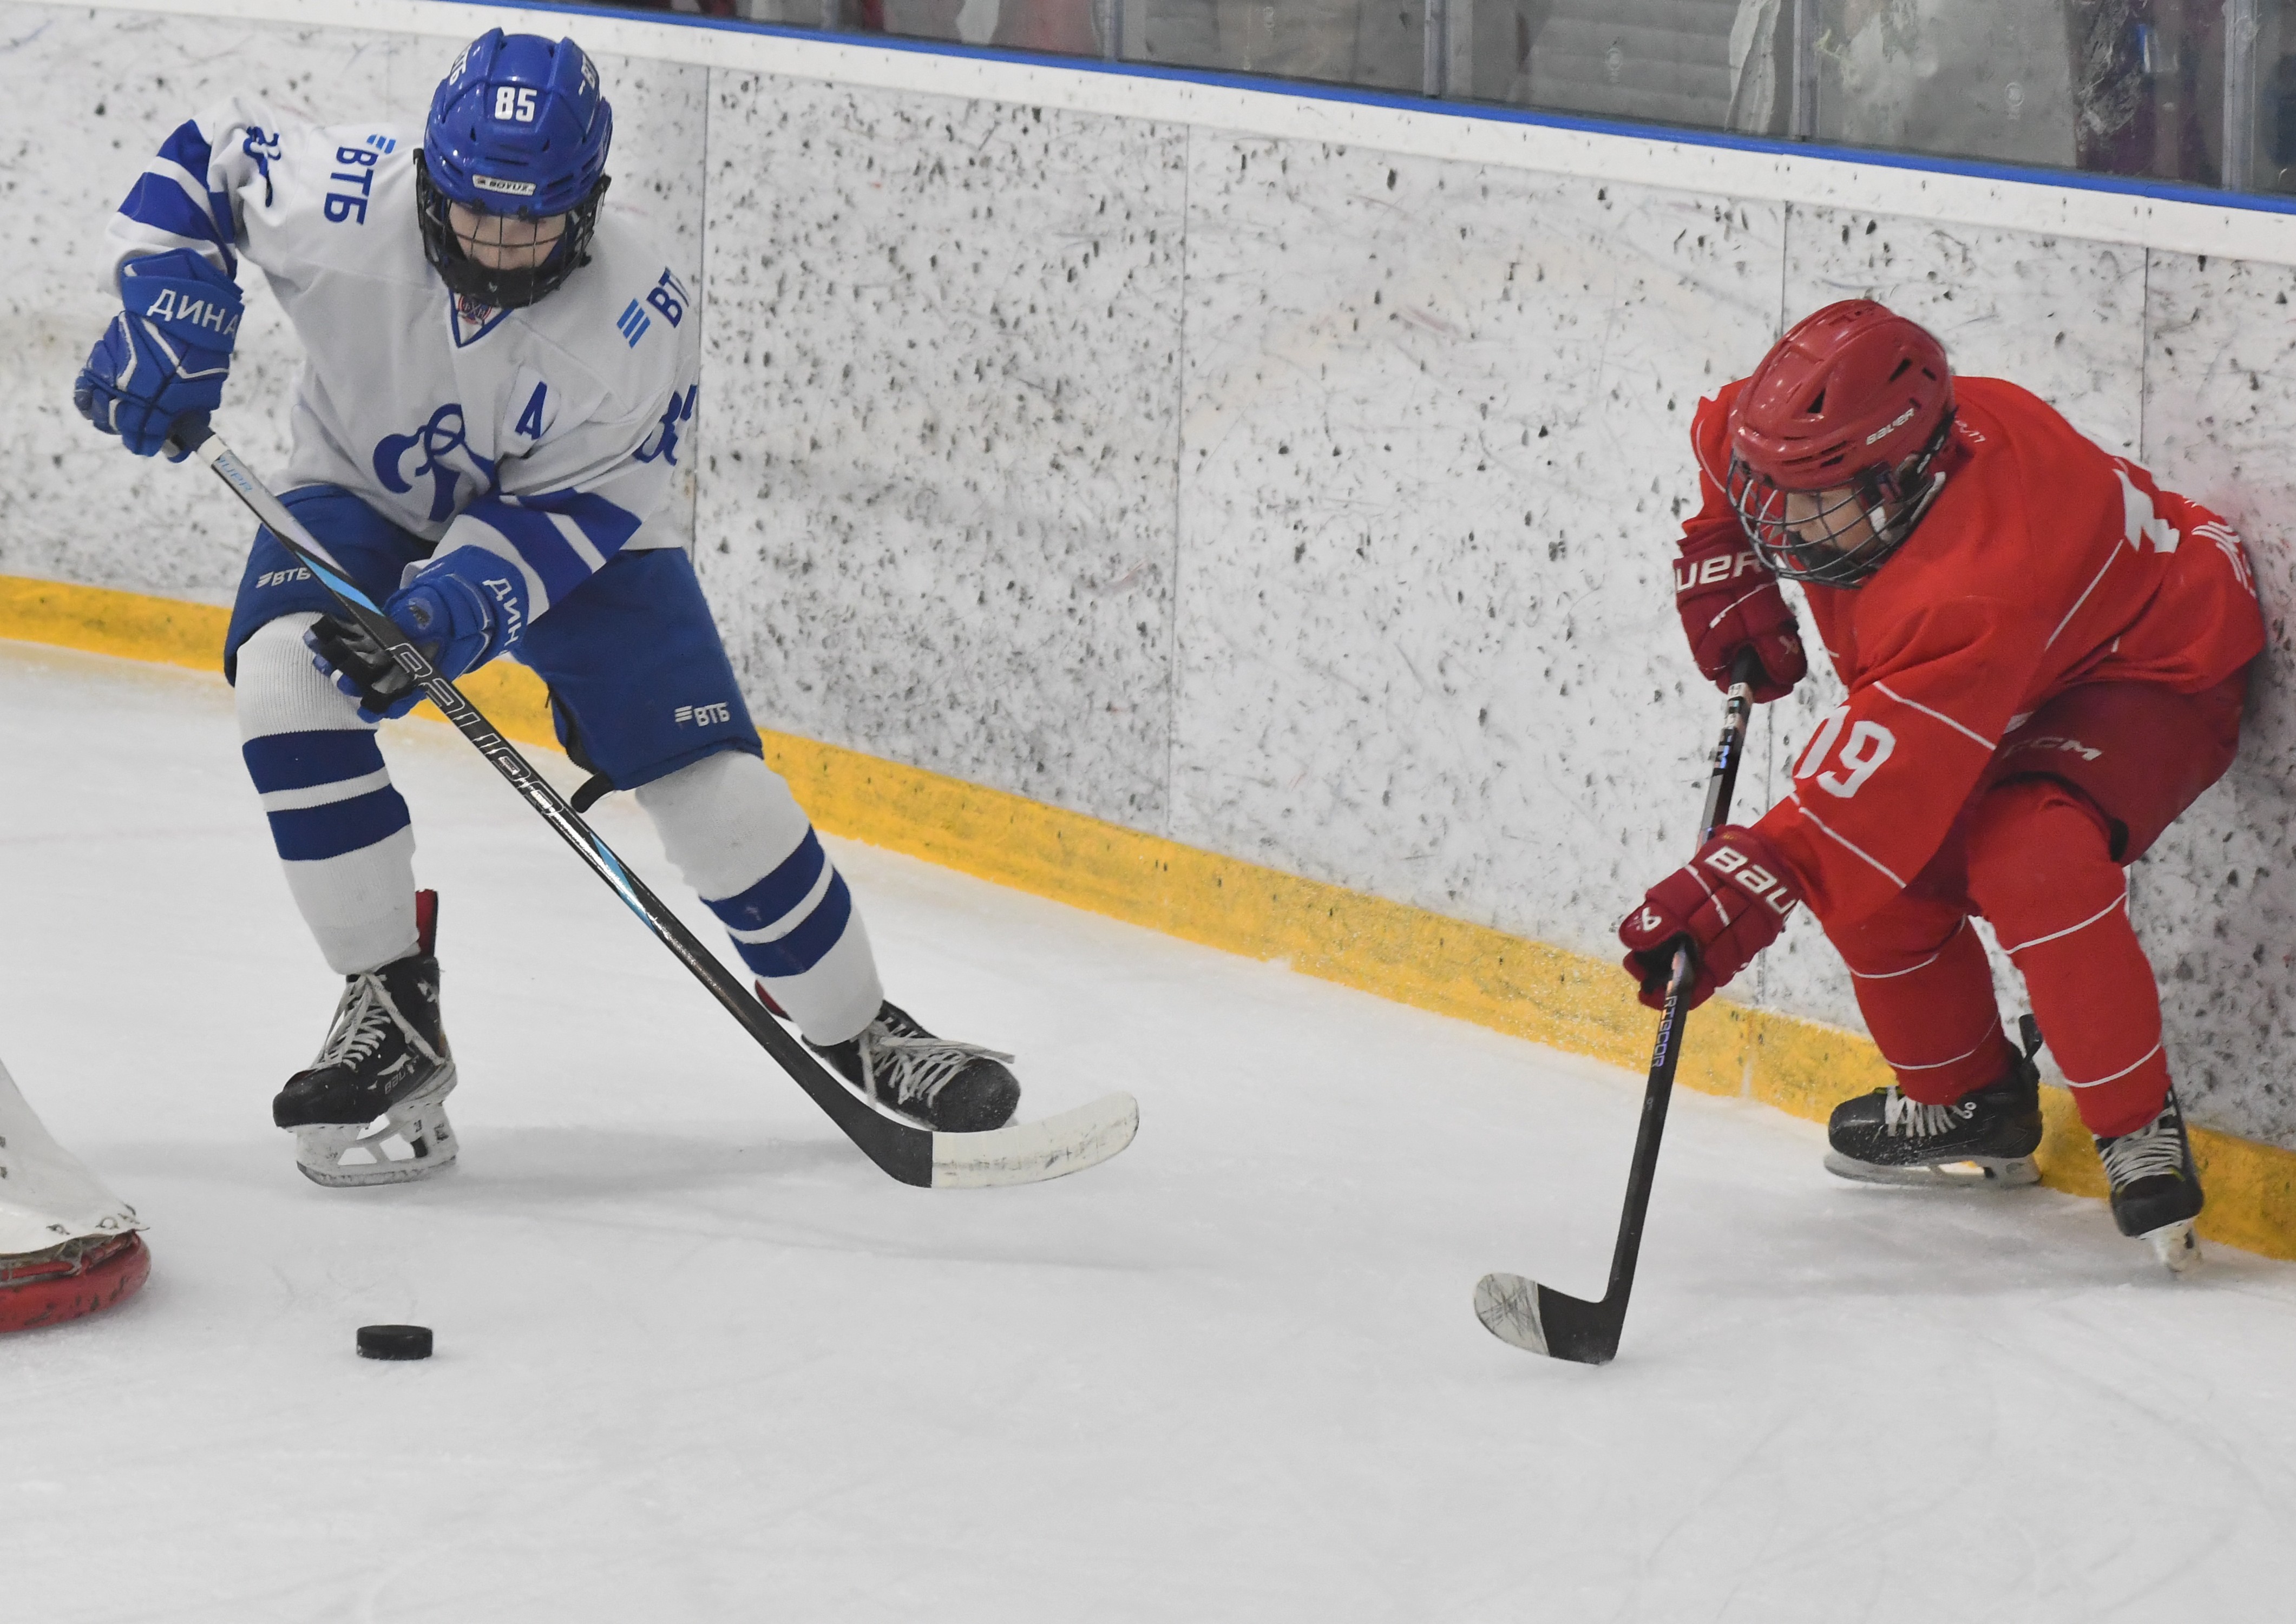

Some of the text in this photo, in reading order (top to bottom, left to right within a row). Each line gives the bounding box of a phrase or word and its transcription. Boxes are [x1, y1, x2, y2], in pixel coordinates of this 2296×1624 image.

[495, 86, 537, 122] 85
[324, 146, 378, 226] ВТБ
[646, 265, 691, 328] ВТ
[271, 567, 311, 587] ВТБ
[482, 578, 522, 655] ДИН
[693, 702, 730, 726] ВТБ
